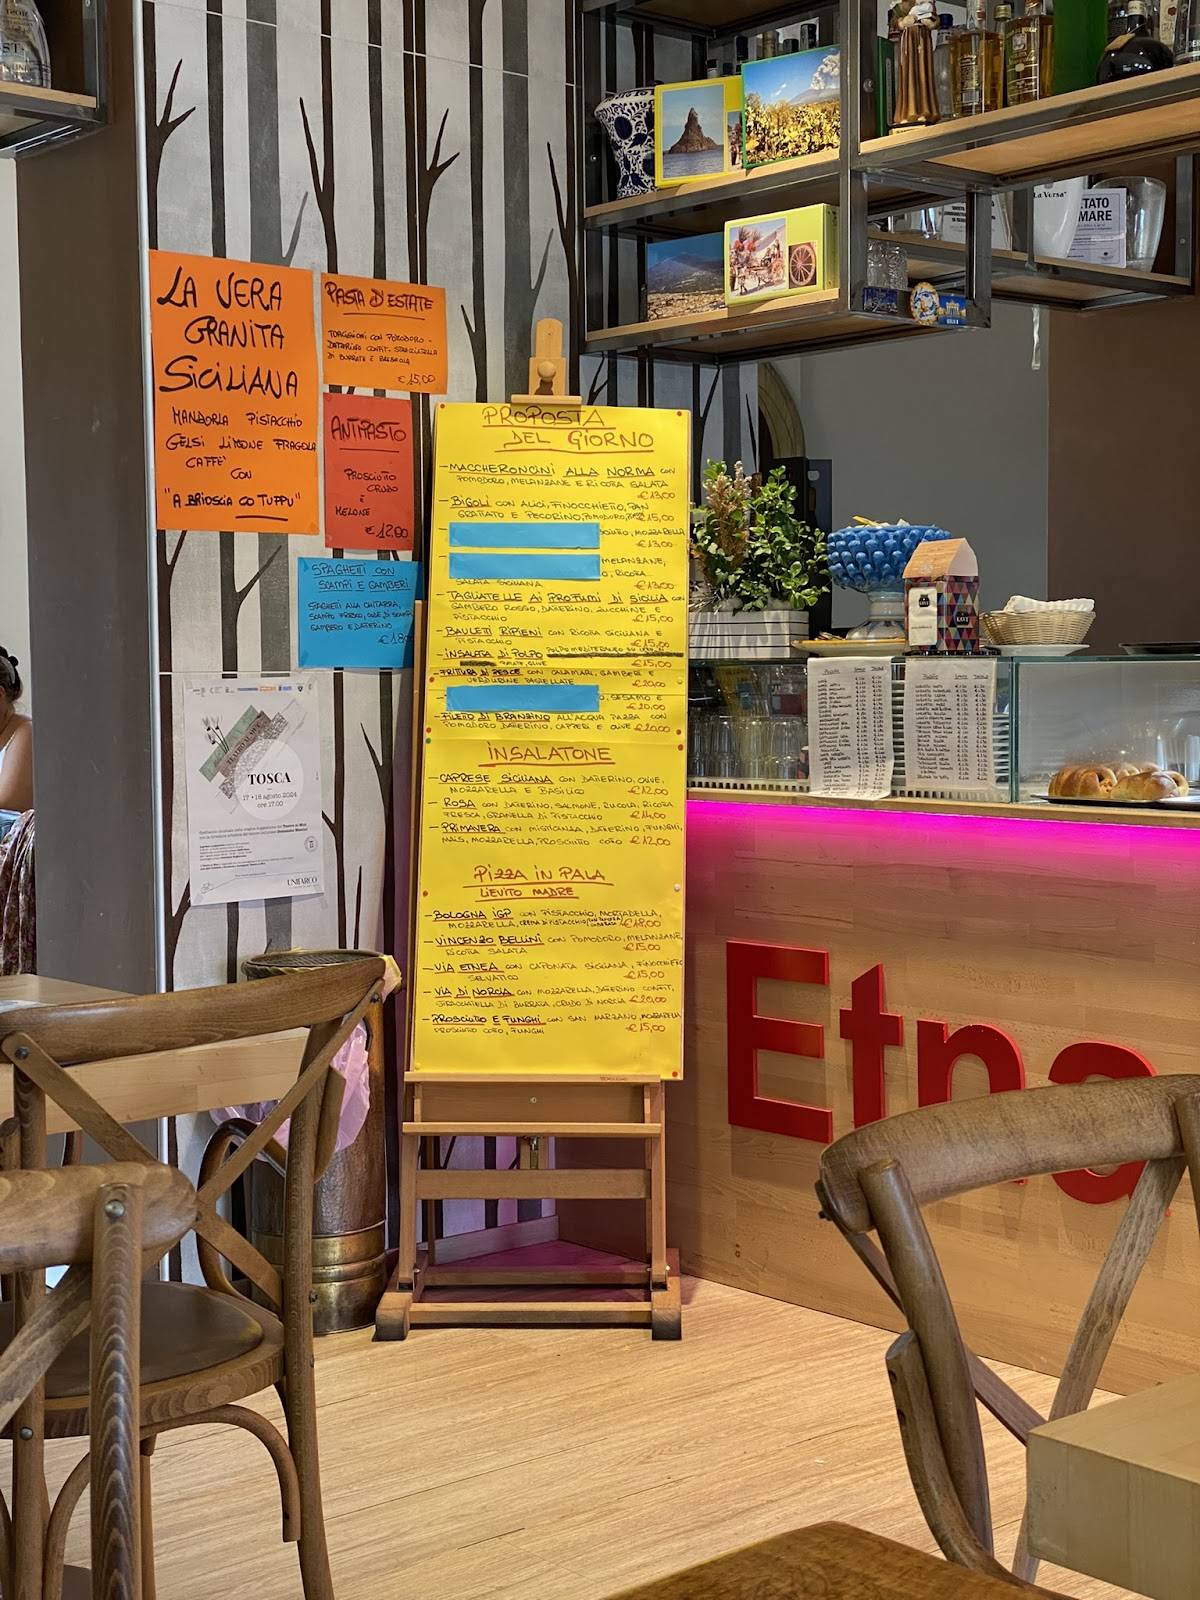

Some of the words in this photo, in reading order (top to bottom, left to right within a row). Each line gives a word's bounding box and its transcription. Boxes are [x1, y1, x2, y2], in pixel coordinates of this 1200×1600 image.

[1080, 197, 1109, 209] TATO
[1078, 210, 1113, 222] MARE
[157, 266, 198, 308] LA
[216, 271, 282, 311] VERA
[325, 281, 365, 311] PASTA
[184, 315, 286, 349] GRANITA
[172, 406, 229, 427] MANDORLA
[482, 406, 604, 427] PROPOSTA
[272, 438, 317, 452] FRAGOLA
[504, 430, 551, 449] DEL
[568, 429, 654, 450] GIORNO
[231, 467, 252, 480] CON
[564, 466, 600, 477] ALLA
[607, 466, 656, 478] NORMA
[630, 480, 669, 488] SALATA
[336, 505, 370, 517] MELONE
[512, 511, 518, 519] E
[373, 566, 395, 577] CON
[358, 580, 365, 590] E
[511, 648, 545, 659] POLPO
[487, 741, 613, 762] INSALATONE
[247, 771, 292, 785] TOSCA
[439, 772, 491, 783] CAPRESE
[559, 775, 576, 783] CON
[443, 797, 477, 809] ROSA
[441, 822, 502, 834] PRIMAVERA
[474, 864, 529, 883] PIZZA
[559, 866, 605, 881] PALA
[532, 887, 574, 897] MADRE
[433, 910, 488, 921] BOLOGNA
[435, 934, 495, 947] VINCENZO
[434, 961, 455, 974] VIA
[459, 962, 504, 974] ETNEA
[434, 986, 453, 998] VIA
[472, 986, 515, 998] NORCIA
[492, 1015, 500, 1025] E
